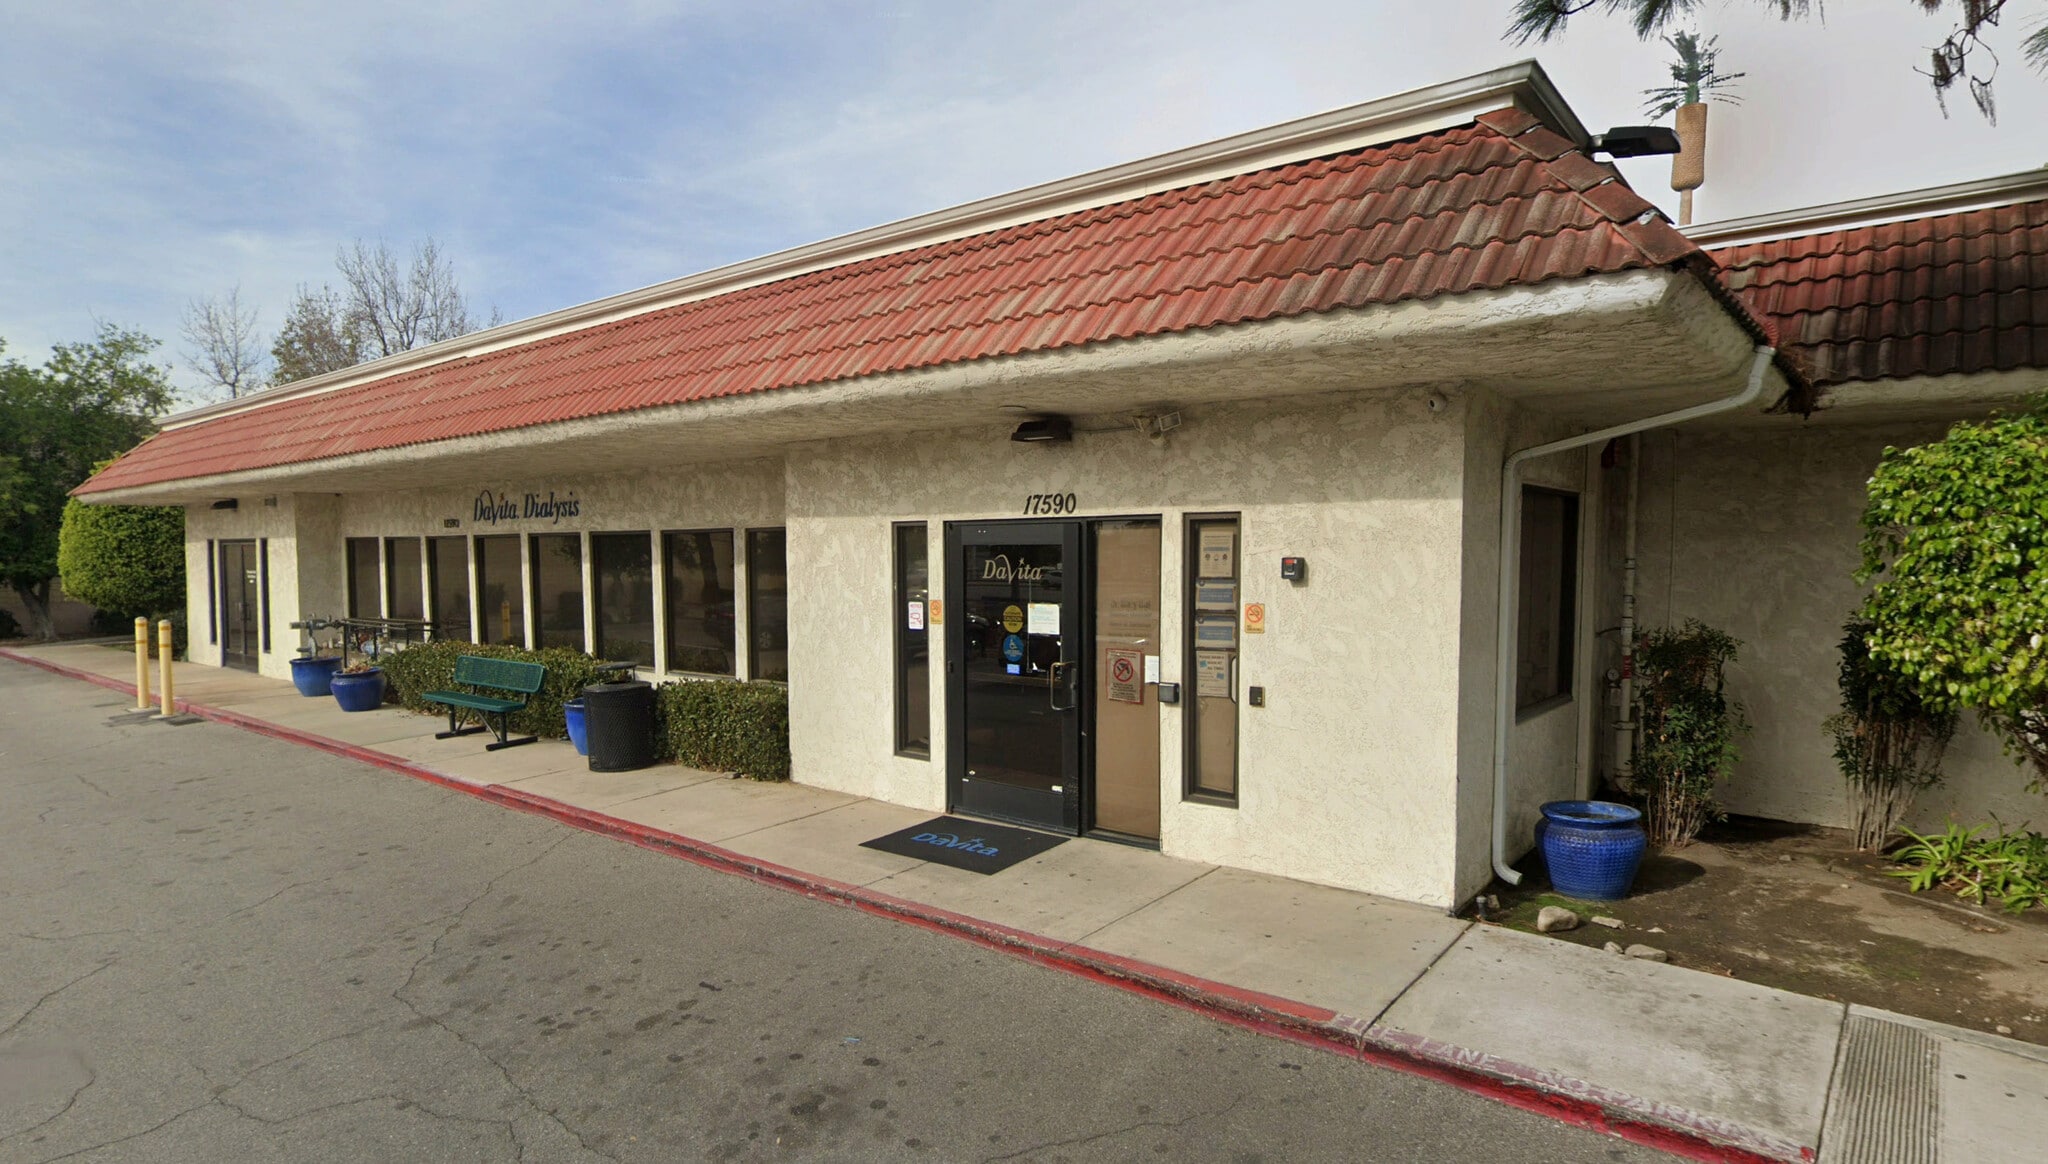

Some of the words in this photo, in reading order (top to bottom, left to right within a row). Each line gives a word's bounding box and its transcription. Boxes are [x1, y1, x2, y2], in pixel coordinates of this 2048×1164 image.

[473, 489, 518, 525] DaVita
[524, 491, 579, 524] Dialysis
[1023, 493, 1077, 515] 17590
[982, 553, 1043, 584] DaVita
[910, 832, 999, 856] DaVita
[1416, 1036, 1501, 1069] LANE
